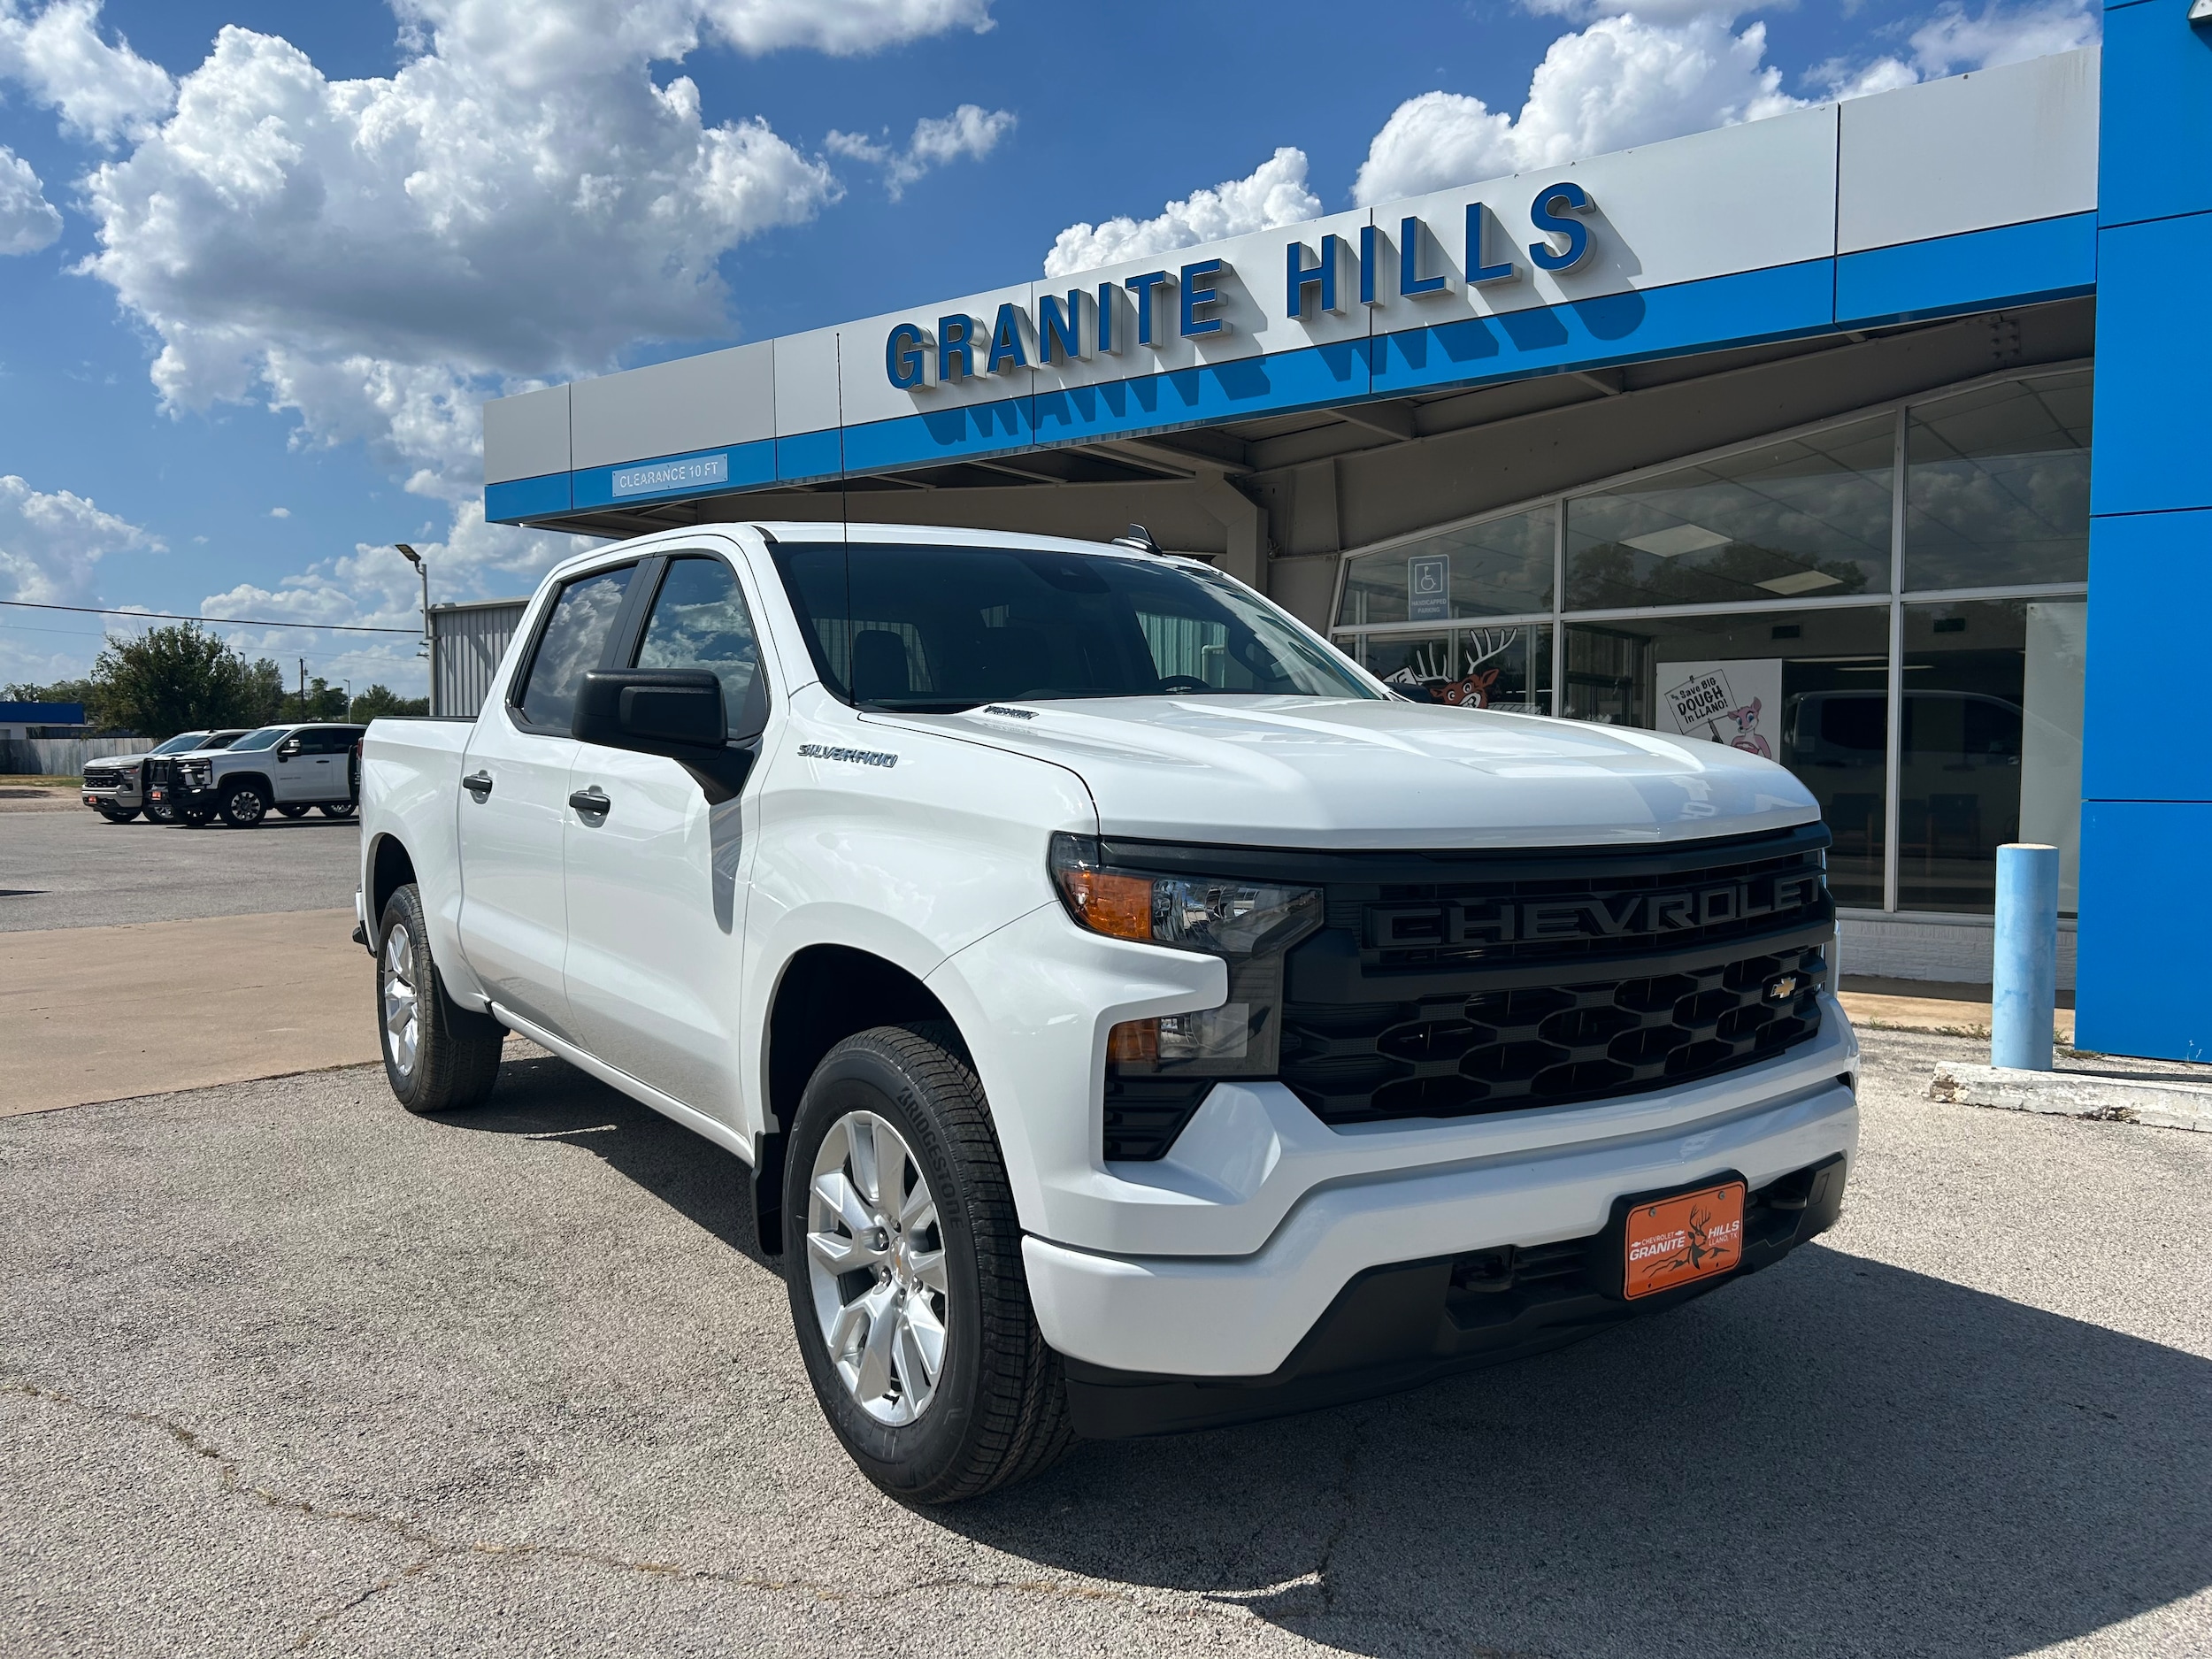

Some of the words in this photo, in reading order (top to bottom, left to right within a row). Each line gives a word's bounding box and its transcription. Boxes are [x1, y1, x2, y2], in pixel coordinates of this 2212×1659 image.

[885, 257, 1228, 391] GRANITE
[1286, 181, 1592, 321] HILLS
[619, 466, 686, 488] CLEARANCE
[689, 465, 702, 479] 10
[704, 461, 718, 476] FT
[1411, 598, 1447, 607] HANDICAPPED
[1677, 685, 1724, 716] DOUGH
[1679, 685, 1700, 699] Save
[1701, 677, 1717, 690] BIG
[1694, 698, 1729, 719] LLANO!
[797, 743, 899, 769] SILVERADO
[1369, 872, 1823, 948] CHEVROLET
[895, 1086, 965, 1230] BRIDGESTONE
[1629, 1236, 1686, 1261] GRANITE
[1708, 1220, 1740, 1239] HILLS
[1641, 1231, 1674, 1246] CHEVROLET
